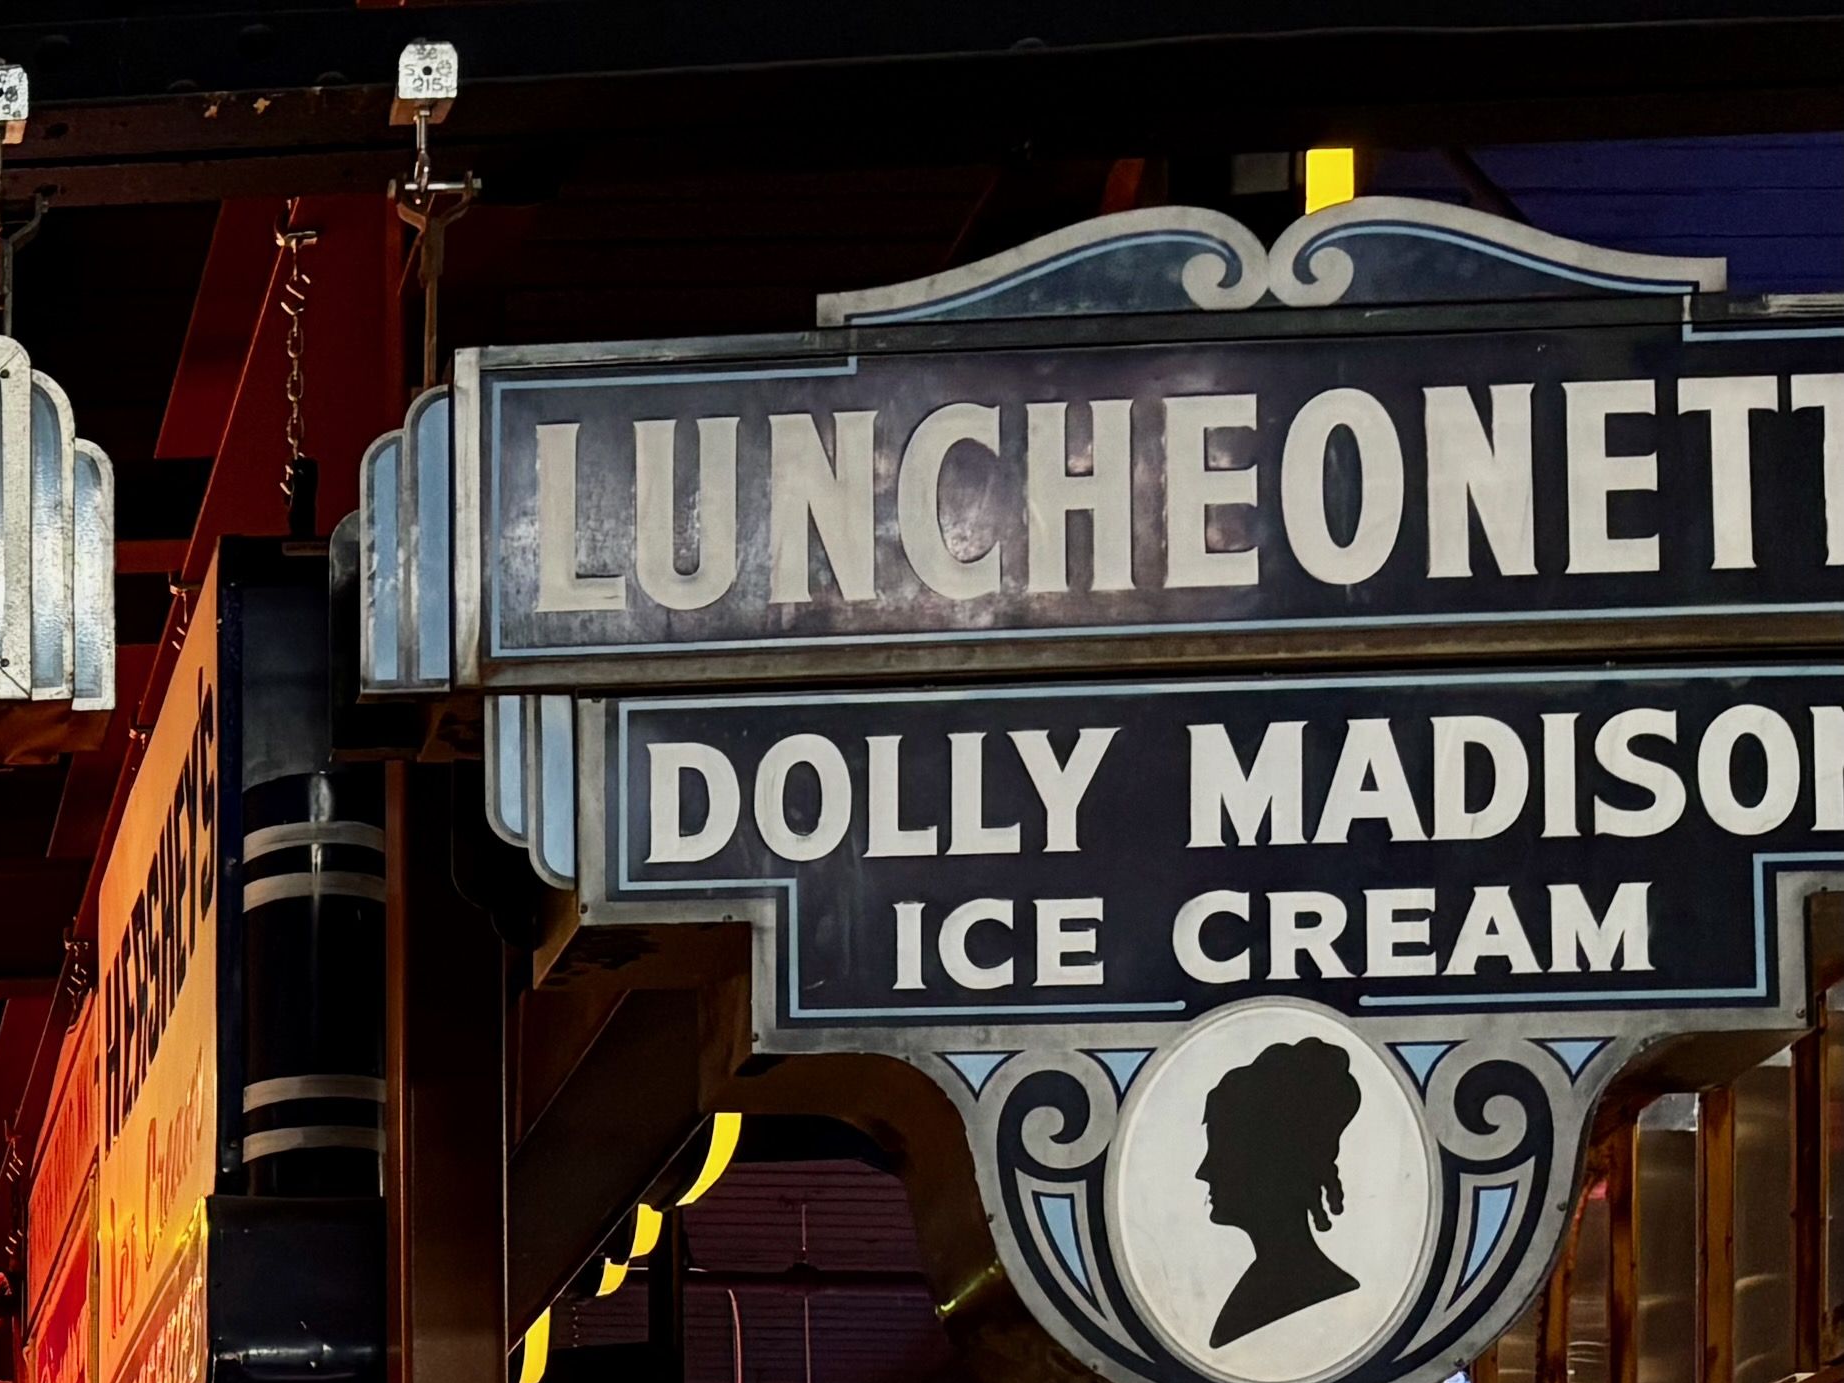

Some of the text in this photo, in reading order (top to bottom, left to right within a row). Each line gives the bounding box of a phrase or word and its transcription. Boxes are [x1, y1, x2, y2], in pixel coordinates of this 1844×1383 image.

[644, 726, 1121, 864] DOLLY
[104, 665, 214, 1164] HERSHEY'S
[892, 881, 1655, 991] ICE CREAM
